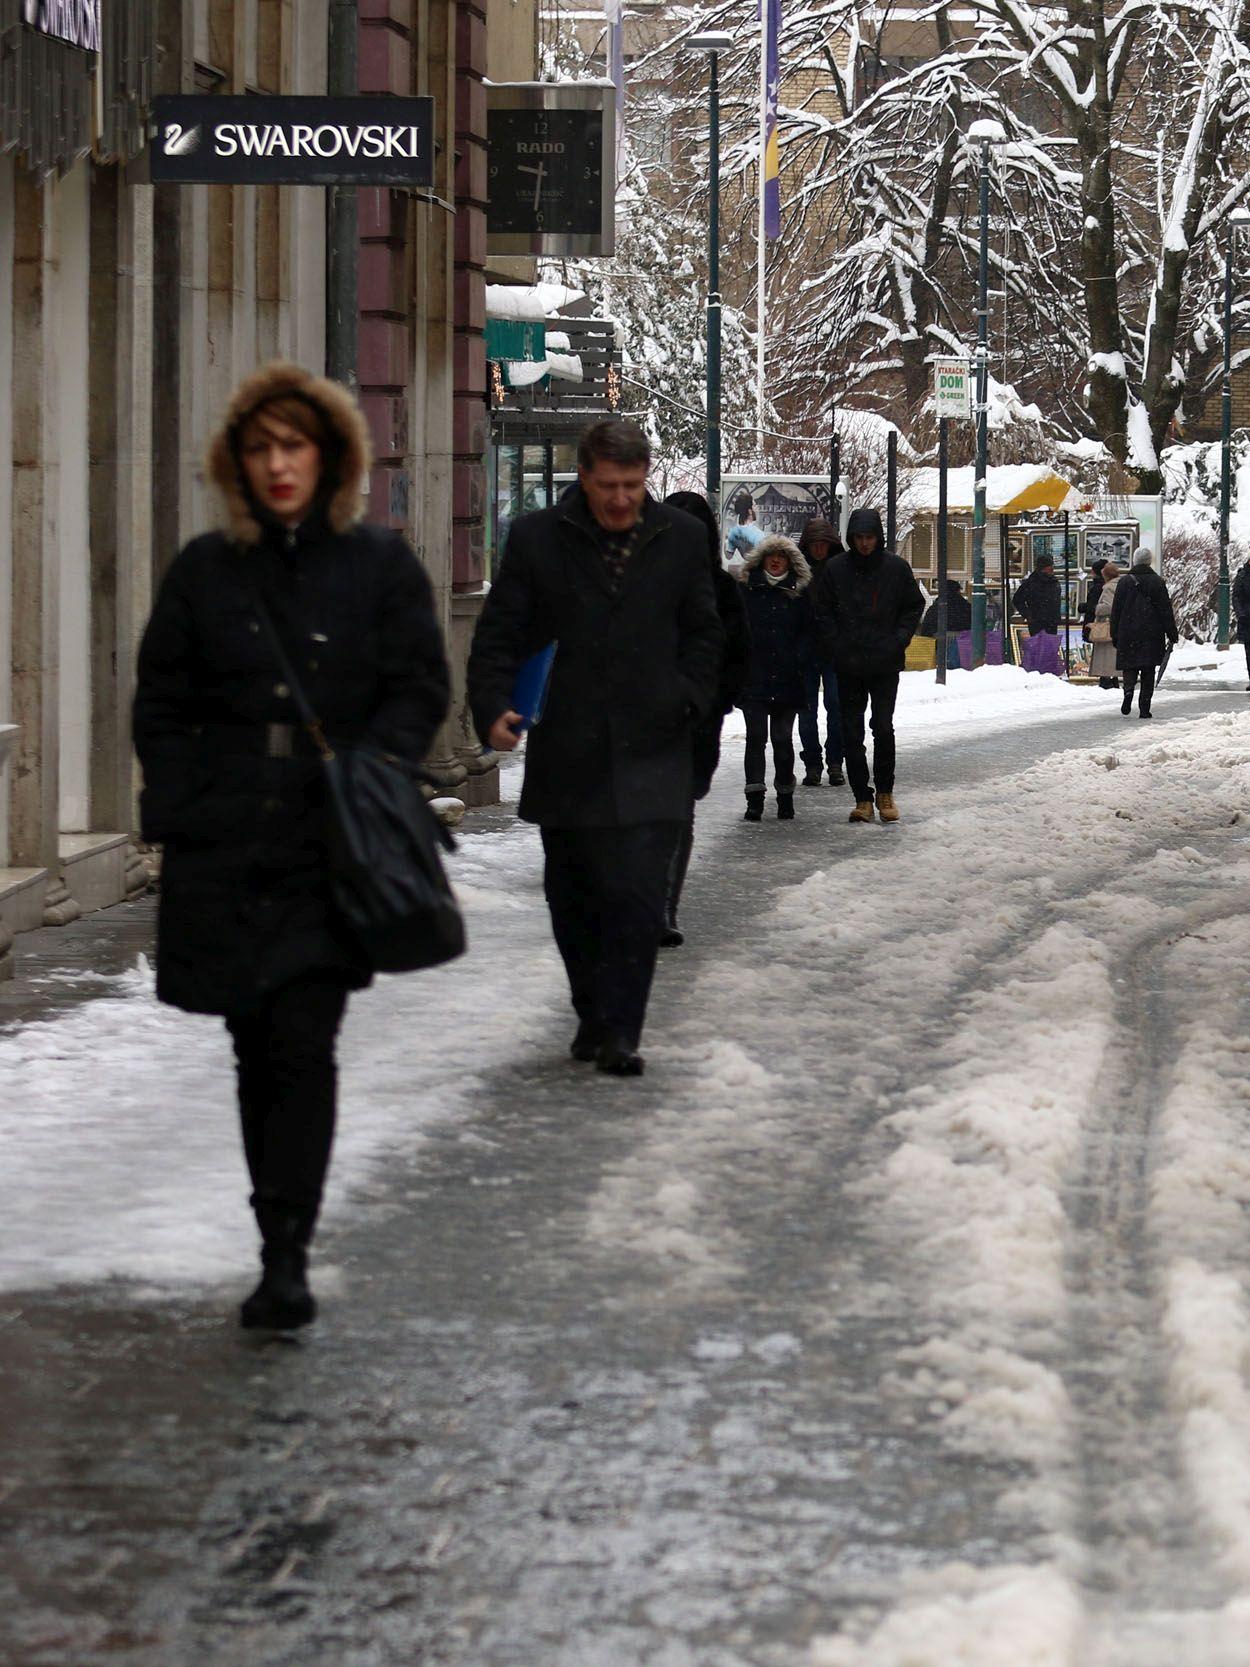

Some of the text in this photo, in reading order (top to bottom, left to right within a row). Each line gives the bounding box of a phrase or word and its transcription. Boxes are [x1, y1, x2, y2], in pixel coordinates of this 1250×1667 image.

[214, 124, 420, 158] SWAROVSKI
[516, 142, 565, 154] RADO
[583, 166, 592, 180] 3
[536, 211, 545, 223] 6
[940, 375, 963, 389] DOM
